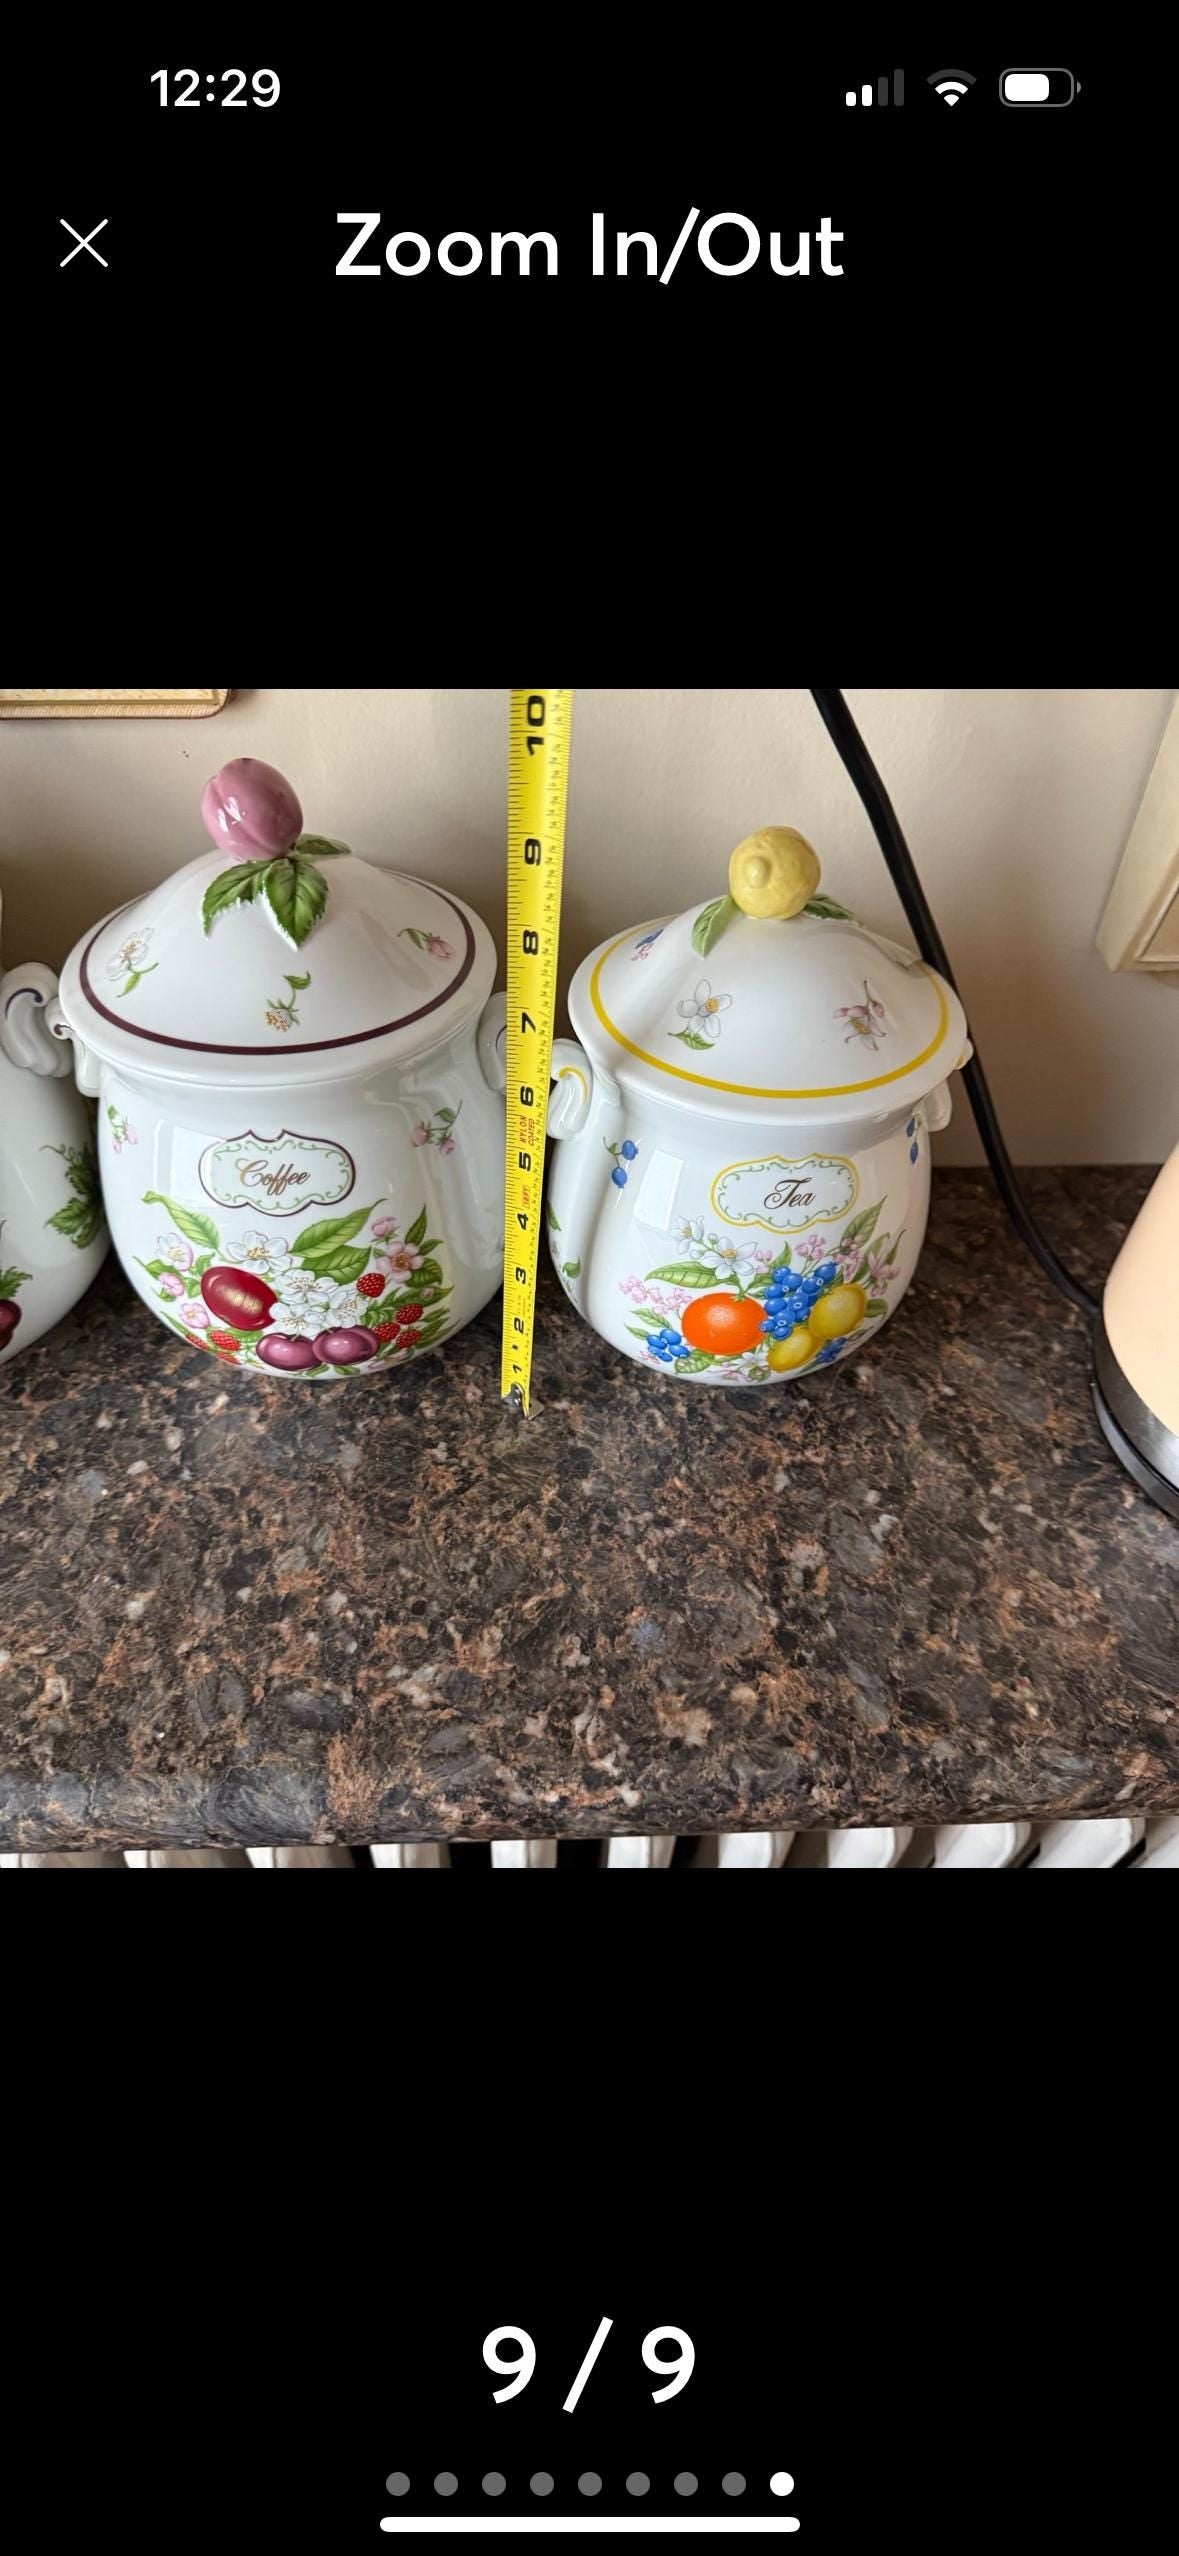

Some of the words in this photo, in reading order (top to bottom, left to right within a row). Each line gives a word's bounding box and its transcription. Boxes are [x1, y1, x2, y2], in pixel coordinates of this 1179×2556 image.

[151, 69, 280, 107] 12:29
[336, 213, 558, 276] Zoom
[593, 207, 844, 285] In/Out
[526, 695, 545, 756] 10
[524, 838, 541, 866] 9
[523, 930, 538, 956] 8
[521, 1012, 537, 1034] 7
[520, 1086, 534, 1107] 6
[519, 1116, 528, 1143] NYLON
[527, 1118, 535, 1147] COATED
[518, 1152, 532, 1172] 5
[235, 1158, 310, 1196] Coffee
[763, 1177, 816, 1210] Tea
[517, 1213, 529, 1230] 4
[515, 1266, 526, 1285] 3
[513, 1317, 525, 1335] 2
[512, 1364, 522, 1374] 1
[483, 2326, 536, 2403] 9
[642, 2326, 695, 2403] 9
